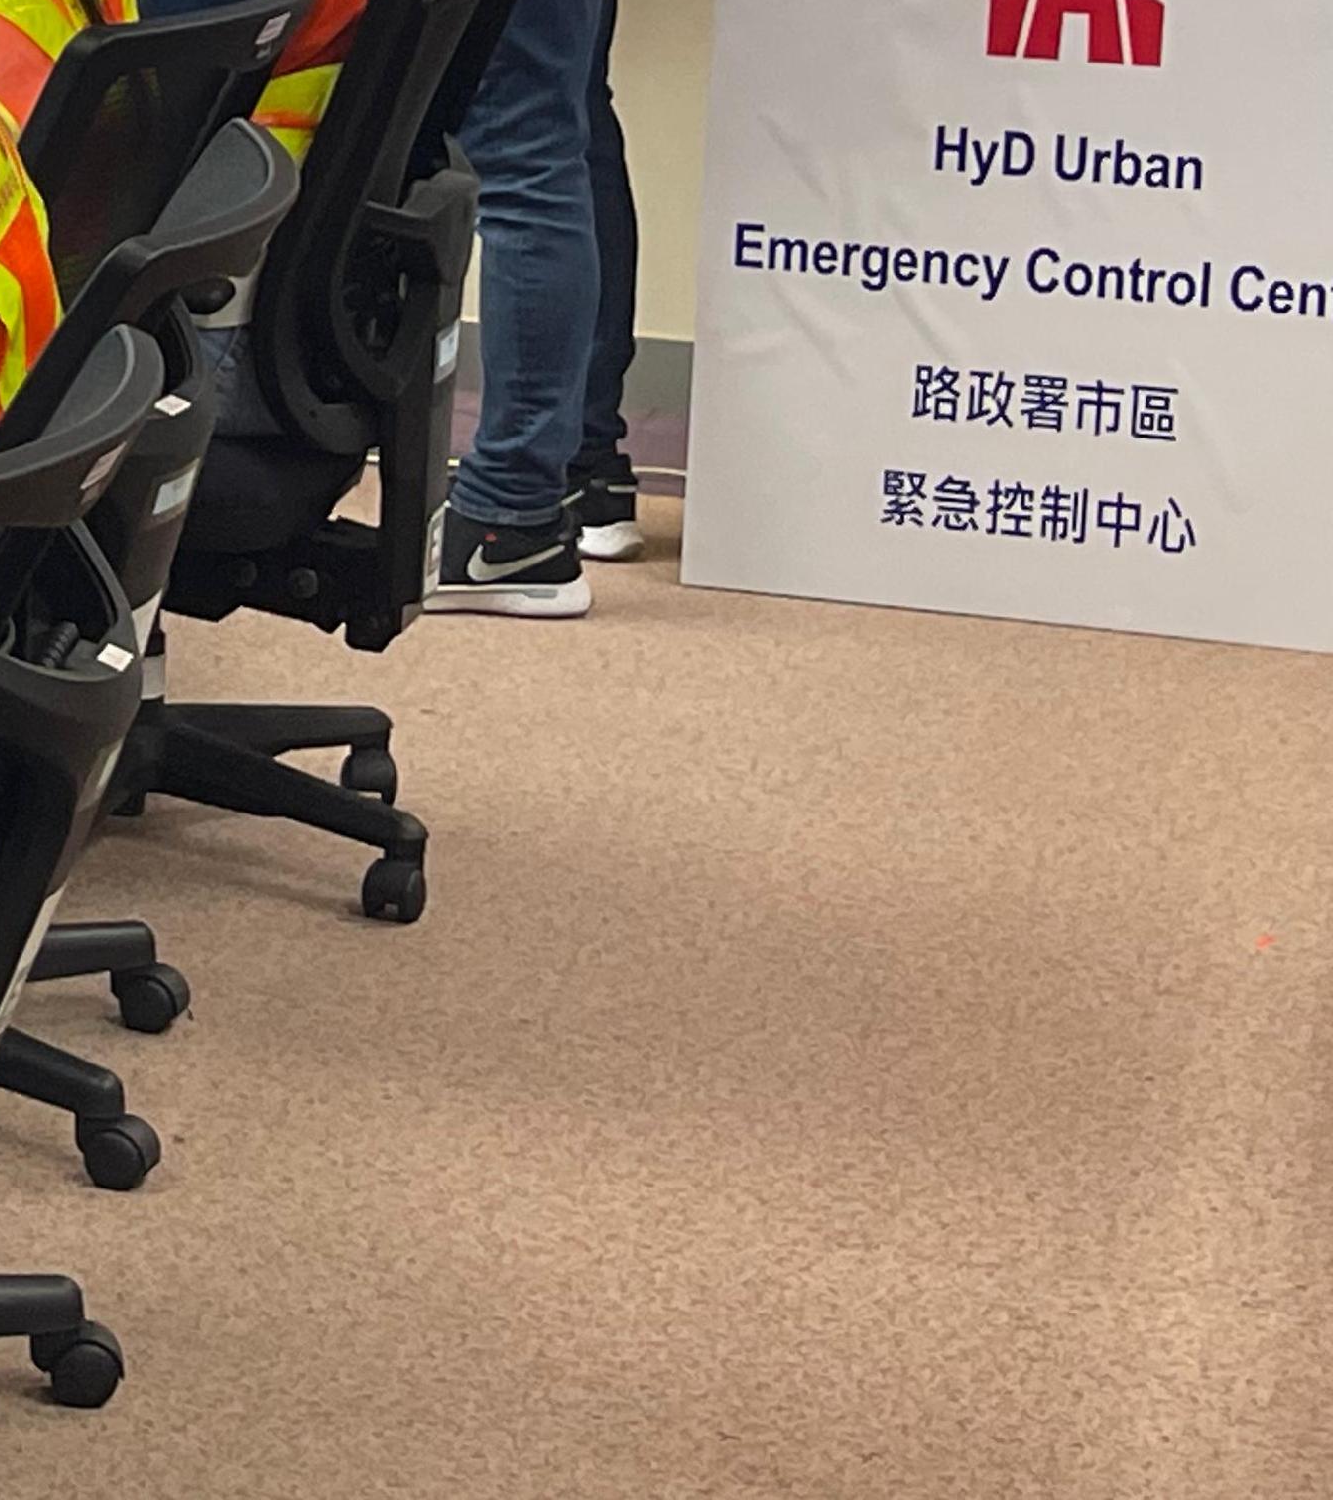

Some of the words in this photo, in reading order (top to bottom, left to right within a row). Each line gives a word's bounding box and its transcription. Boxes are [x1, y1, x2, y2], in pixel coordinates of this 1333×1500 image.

[934, 125, 1036, 187] HyD
[1054, 133, 1203, 191] Urban
[734, 222, 1010, 301] Emergency
[1026, 247, 1212, 309] Control
[1230, 265, 1333, 318] Cen
[911, 364, 1179, 442] 路政署市區
[880, 469, 1197, 554] 緊急控制中心
